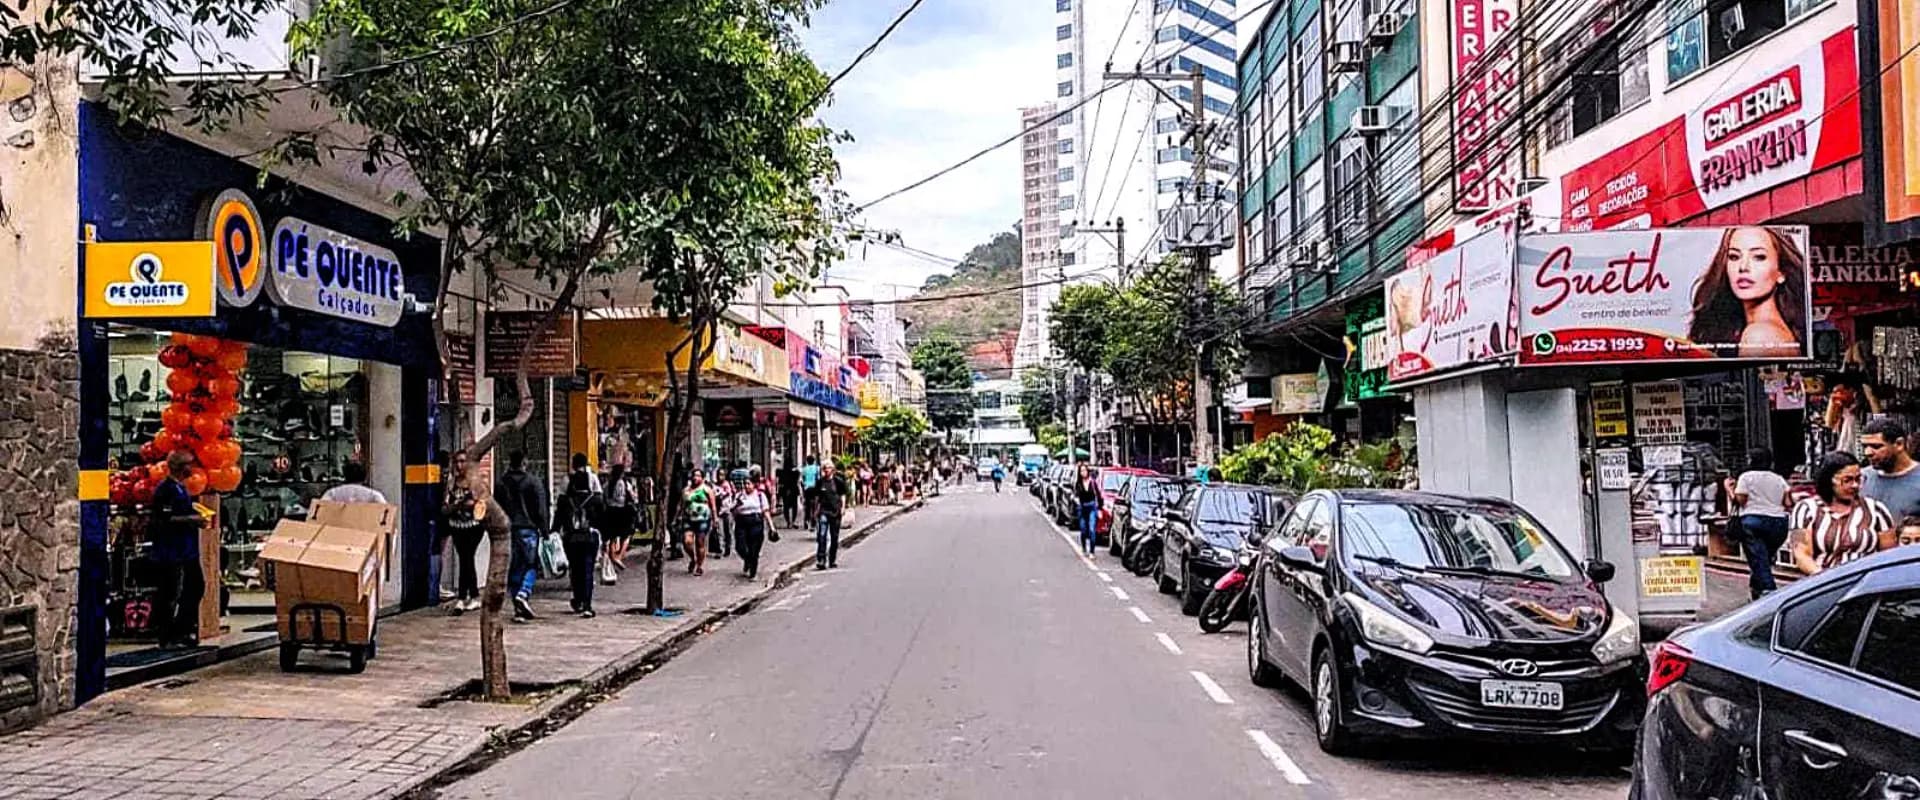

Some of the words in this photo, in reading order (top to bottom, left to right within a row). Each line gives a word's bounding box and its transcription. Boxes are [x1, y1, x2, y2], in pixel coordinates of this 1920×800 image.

[1704, 77, 1796, 142] GALERIA
[1700, 119, 1806, 193] FRANKLIN
[1605, 171, 1637, 197] TECIDOS
[1598, 184, 1648, 217] DECORAÇÕES
[278, 224, 308, 278] PÉ
[316, 240, 399, 301] QUENTE
[1809, 245, 1913, 264] ALERIA
[1531, 232, 1670, 316] Sueth
[130, 284, 184, 298] QUENTE
[319, 288, 376, 317] Calçados
[1581, 308, 1616, 320] centro
[1617, 308, 1631, 318] de
[1572, 339, 1607, 351] 2252
[1612, 338, 1644, 350] 1993
[1485, 690, 1514, 704] LRK
[1520, 691, 1560, 706] 7708
